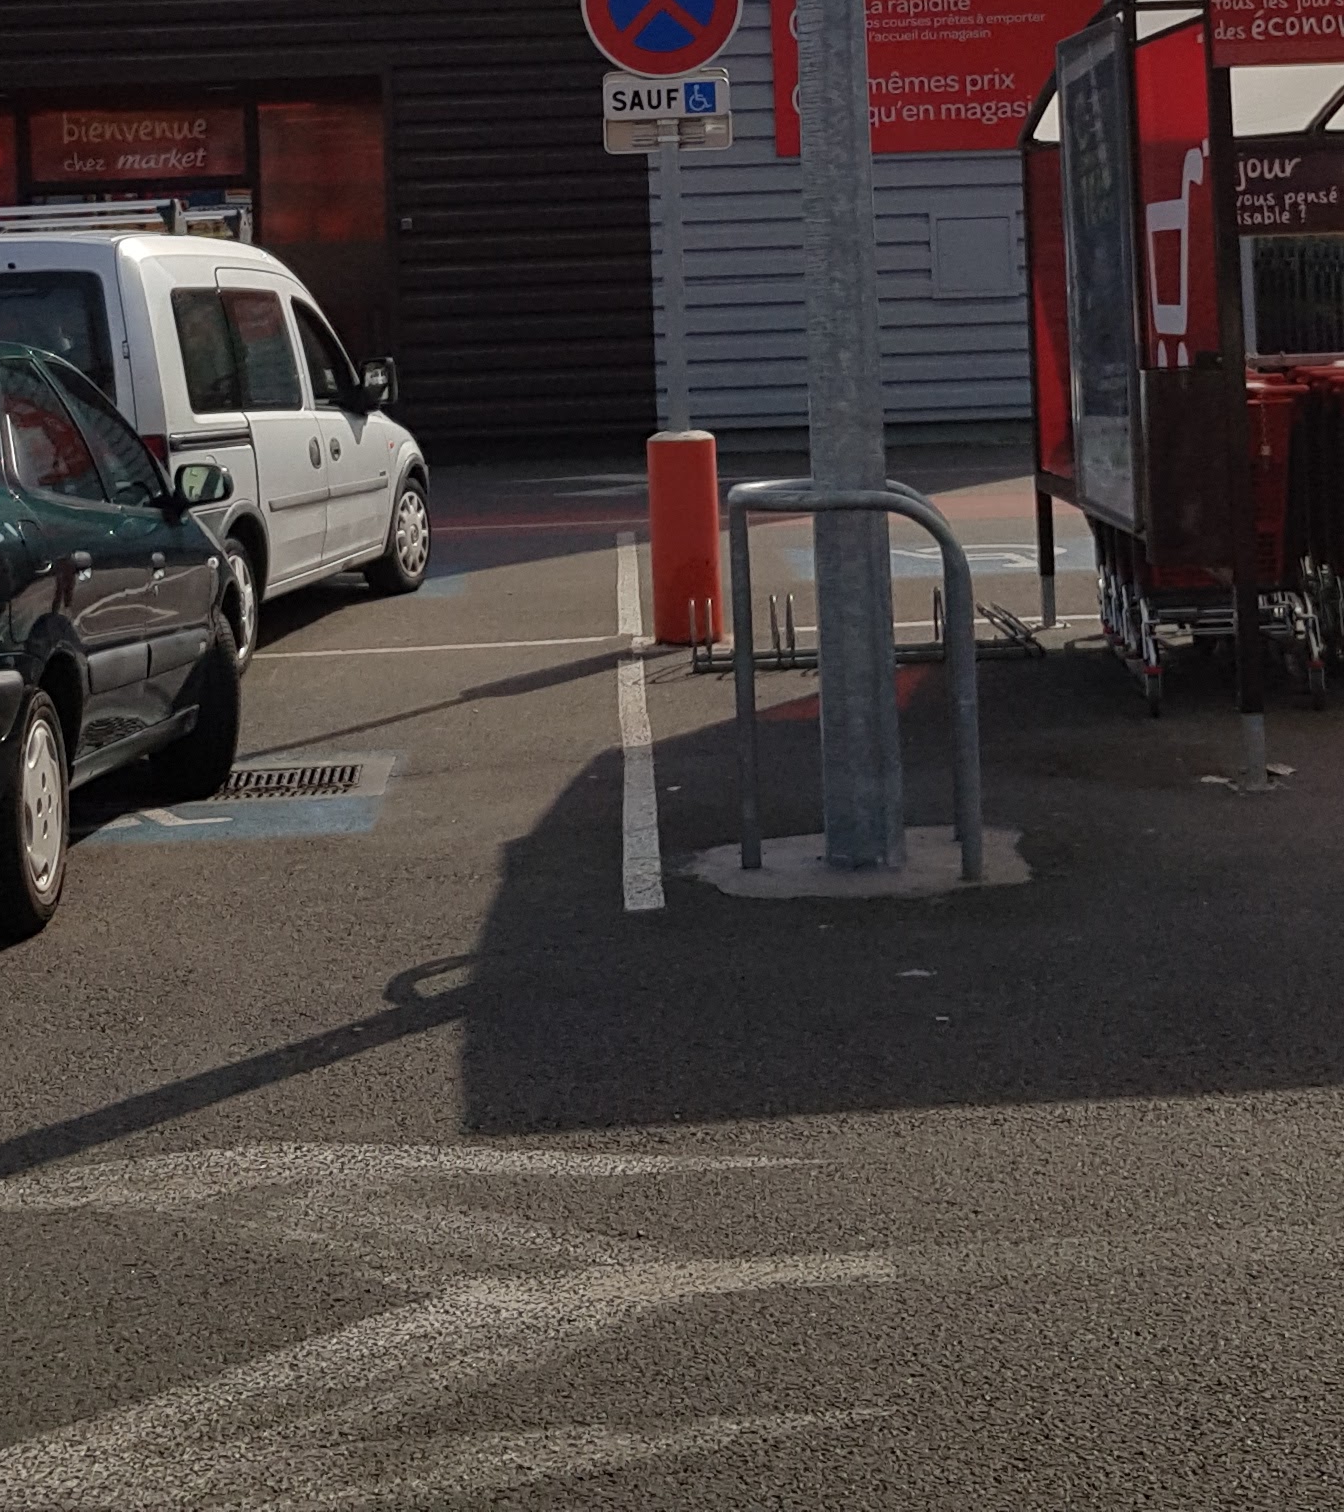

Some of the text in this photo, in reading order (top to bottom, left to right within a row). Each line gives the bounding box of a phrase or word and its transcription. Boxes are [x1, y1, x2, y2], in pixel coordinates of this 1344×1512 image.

[865, 19, 880, 29] os
[882, 17, 932, 29] courses
[986, 12, 1045, 27] emporter
[1214, 21, 1246, 41] des
[921, 28, 937, 41] du
[940, 28, 991, 42] magasin
[868, 67, 1015, 96] mêmes prix
[612, 88, 679, 111] SAUF
[941, 95, 1033, 125] magasi
[63, 112, 207, 144] bienvenue
[64, 147, 206, 172] chez market
[1284, 185, 1338, 210] pensé
[1298, 205, 1307, 224] ?
